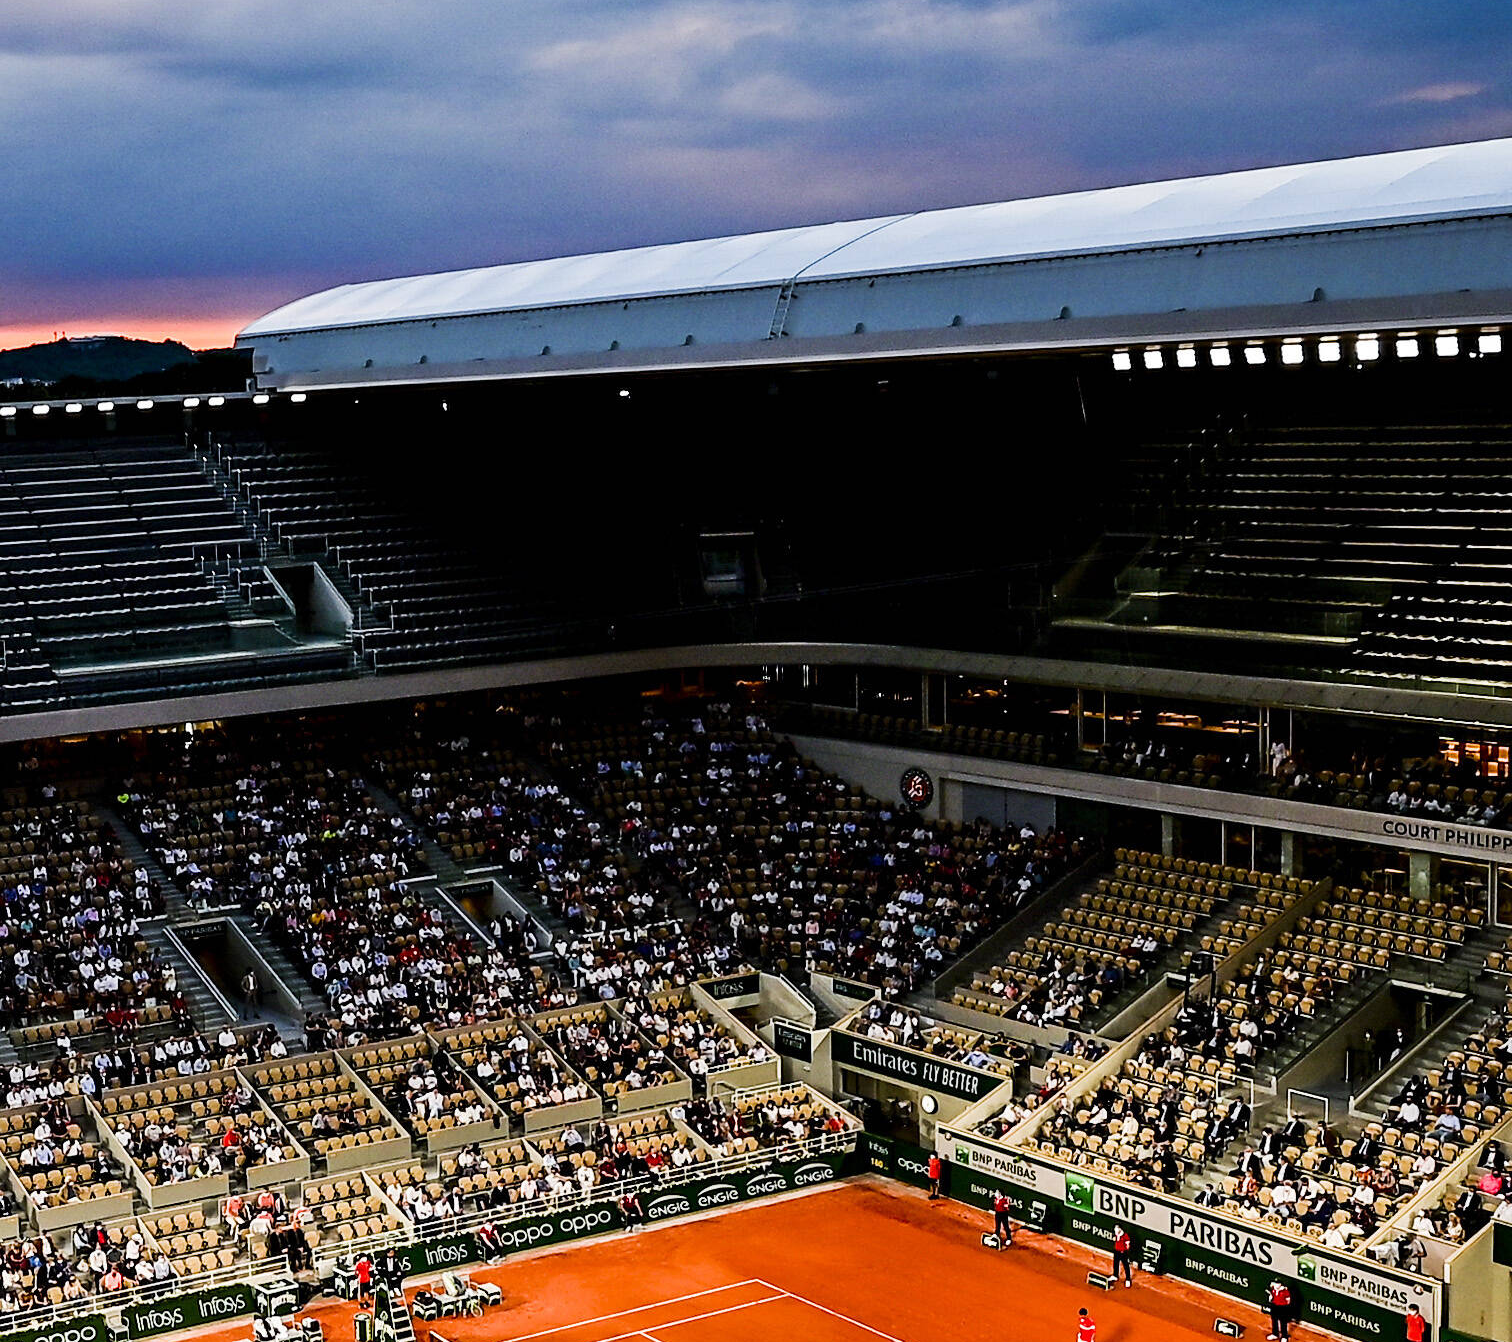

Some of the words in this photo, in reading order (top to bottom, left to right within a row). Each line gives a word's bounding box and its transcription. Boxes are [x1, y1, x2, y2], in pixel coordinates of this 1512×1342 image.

[1383, 821, 1440, 840] COURT
[853, 1041, 918, 1077] Emirates
[923, 1062, 940, 1082] FLY
[942, 1068, 979, 1096] BETTER
[972, 1151, 992, 1165] BNP
[994, 1158, 1036, 1181] PARIBAS
[970, 1183, 988, 1196] BNP
[560, 1209, 612, 1233] oppo
[1072, 1219, 1091, 1235] BNP
[1099, 1188, 1146, 1221] BNP
[1169, 1212, 1273, 1266] PARIBAS
[502, 1223, 553, 1248] oppo
[426, 1242, 468, 1267] Infosys
[1185, 1258, 1205, 1274] BNP
[1207, 1266, 1250, 1289] PARIBAS
[1320, 1265, 1348, 1284] BNP
[1350, 1275, 1408, 1305] PARIBAS
[198, 1292, 246, 1319] Infosys
[1310, 1300, 1333, 1316] BNP
[1334, 1310, 1381, 1334] PARIBAS
[136, 1306, 184, 1333] Infosys
